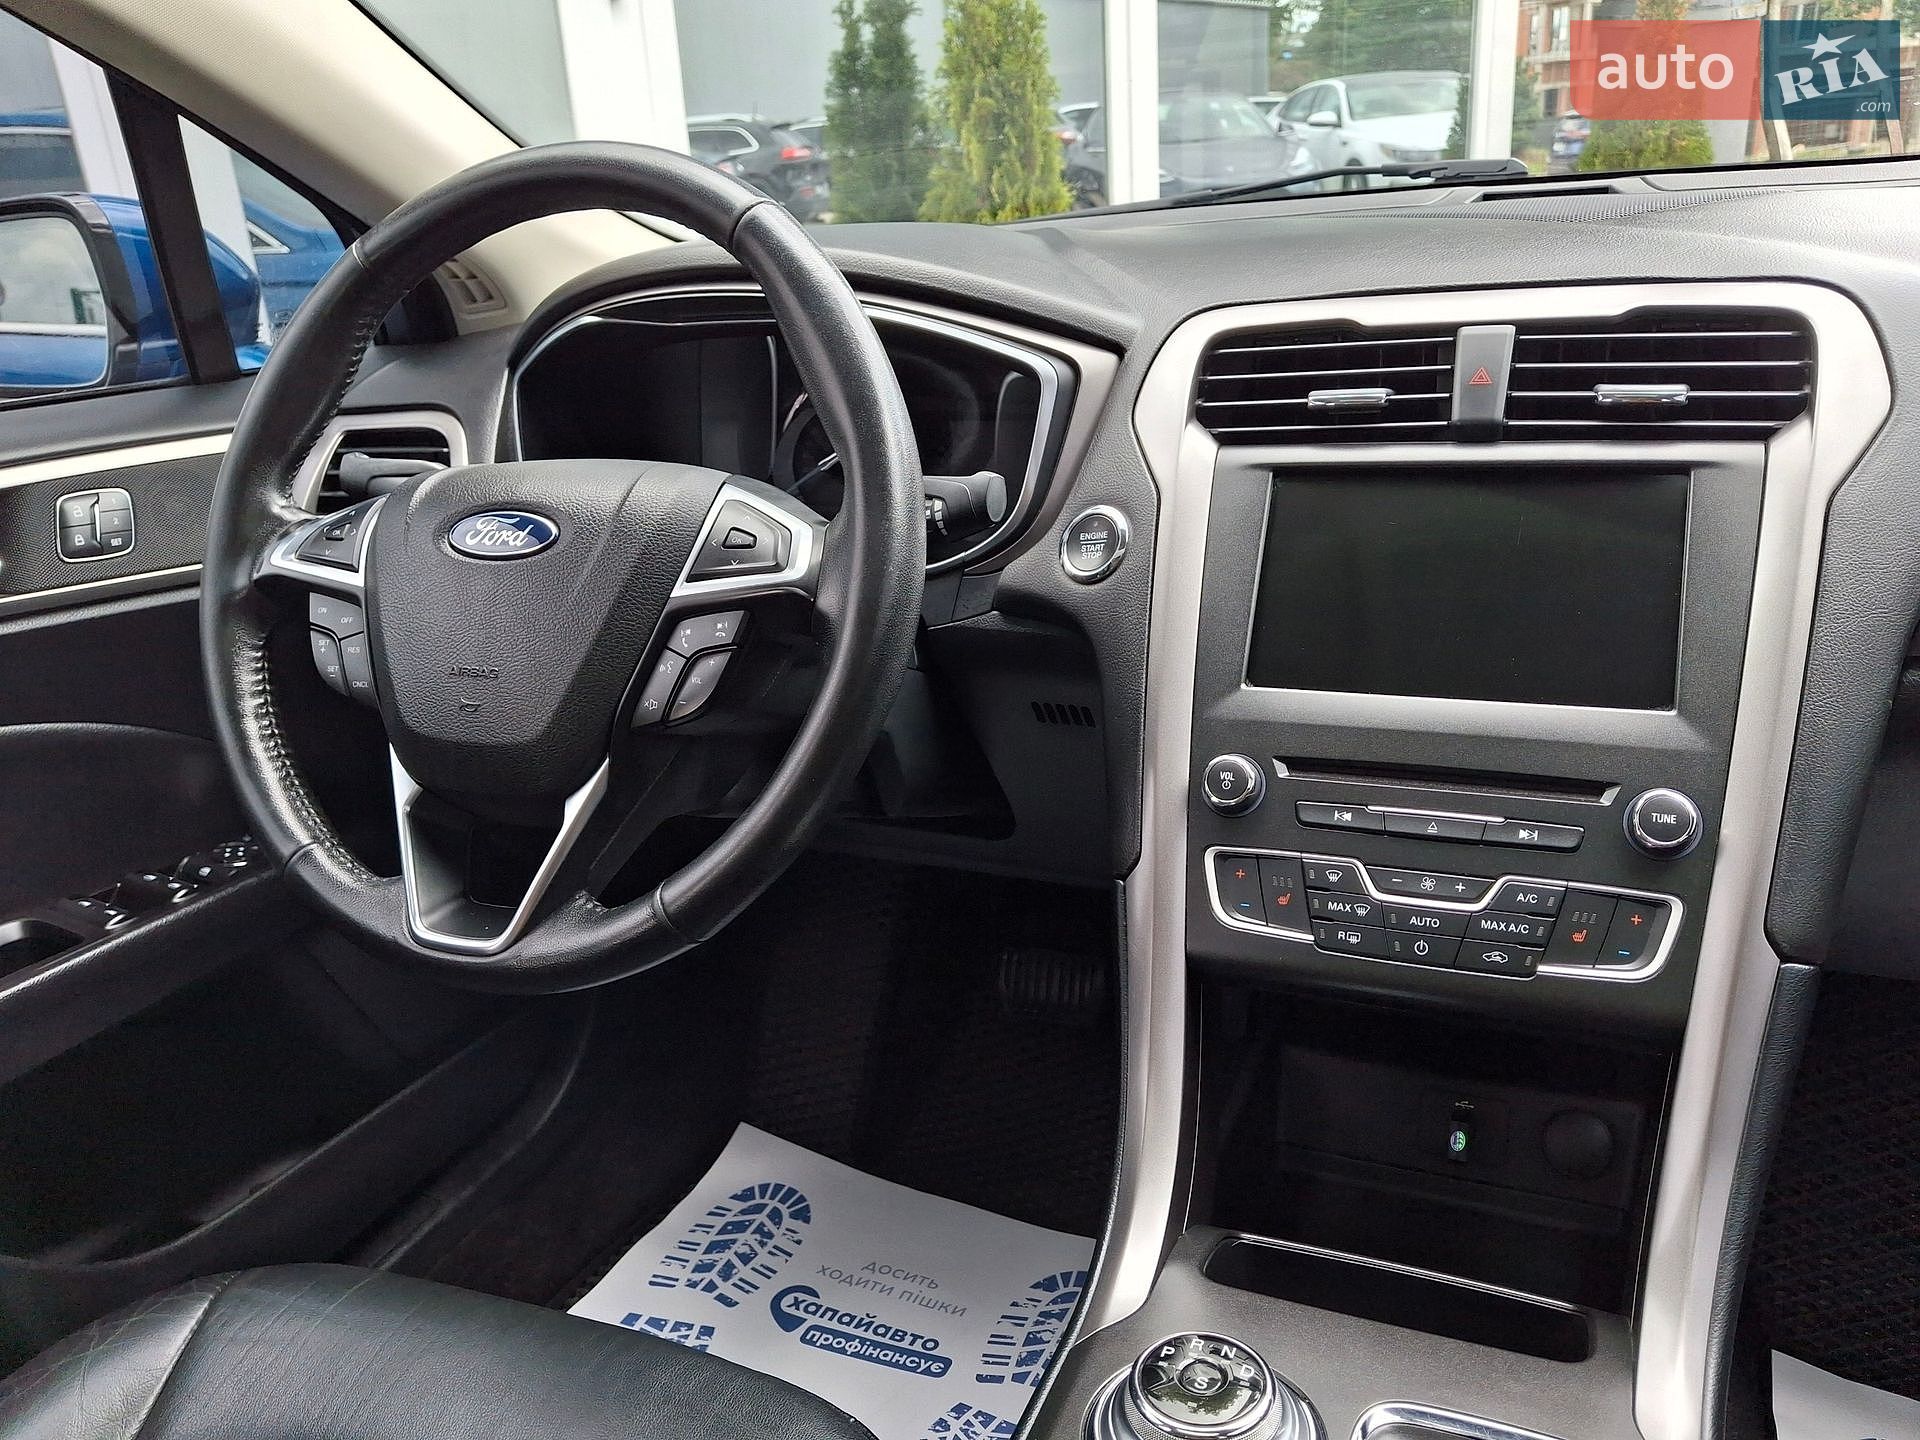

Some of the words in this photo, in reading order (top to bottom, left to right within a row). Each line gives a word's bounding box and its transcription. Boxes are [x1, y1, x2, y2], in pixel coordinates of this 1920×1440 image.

[465, 516, 534, 546] Ford
[1080, 531, 1108, 540] ENGINE
[1081, 551, 1102, 560] STOP
[317, 606, 328, 614] ON
[340, 616, 353, 624] OFF
[347, 646, 360, 654] RES
[327, 665, 339, 673] SET
[449, 665, 499, 679] AIRBAG
[352, 680, 369, 688] CNCL
[1219, 771, 1235, 782] VOL
[1651, 812, 1677, 825] TUNE
[1516, 892, 1538, 904] A/C
[1327, 901, 1352, 913] MAX
[1409, 915, 1440, 928] AUTO
[1480, 919, 1507, 932] MAX
[1508, 922, 1530, 934] A/C
[1337, 931, 1346, 941] R
[786, 1295, 940, 1352] хапайавто
[804, 1328, 945, 1374] профінансує
[1160, 1345, 1176, 1359] P
[1190, 1338, 1205, 1352] R
[1220, 1345, 1237, 1358] N
[1239, 1363, 1255, 1378] D
[1194, 1376, 1208, 1390] S
